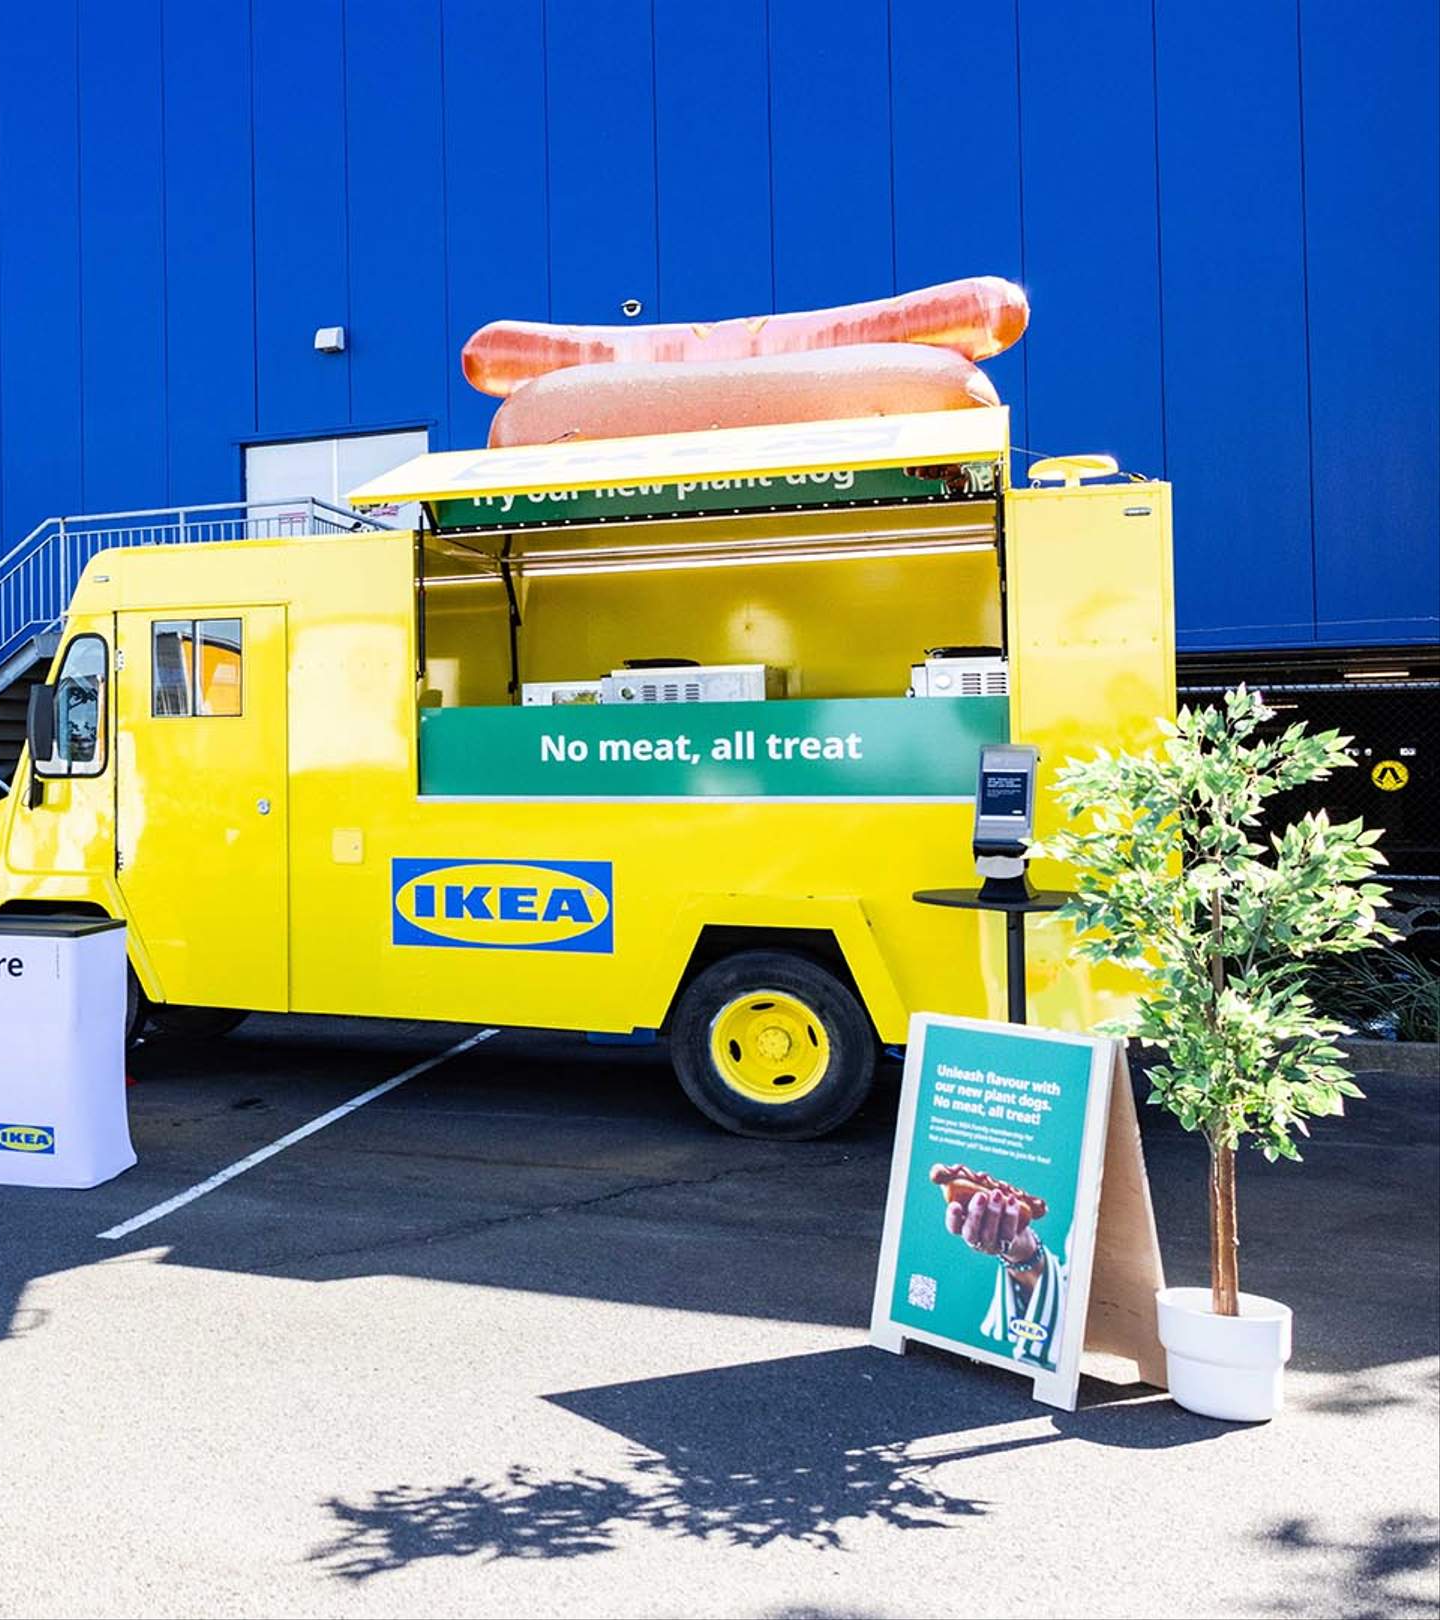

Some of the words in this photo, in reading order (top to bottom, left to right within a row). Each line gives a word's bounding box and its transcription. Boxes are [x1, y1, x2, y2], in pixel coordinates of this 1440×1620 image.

[473, 495, 515, 512] ry
[541, 735, 588, 762] No
[598, 734, 700, 765] meat,
[711, 731, 755, 760] all
[766, 732, 863, 760] treat
[414, 885, 594, 923] IKEA
[937, 1064, 984, 1083] Unleash
[986, 1071, 1030, 1089] flavour
[1031, 1080, 1061, 1096] with
[933, 1094, 951, 1108] No
[951, 1099, 986, 1117] meat,
[988, 1105, 1005, 1119] all
[1006, 1108, 1041, 1125] treat!
[935, 1081, 956, 1094] our
[957, 1085, 983, 1098] new
[984, 1088, 1017, 1104] plant
[1018, 1093, 1052, 1112] dogs.
[1, 1131, 49, 1145] IKEA
[1013, 1322, 1044, 1338] IKEA
